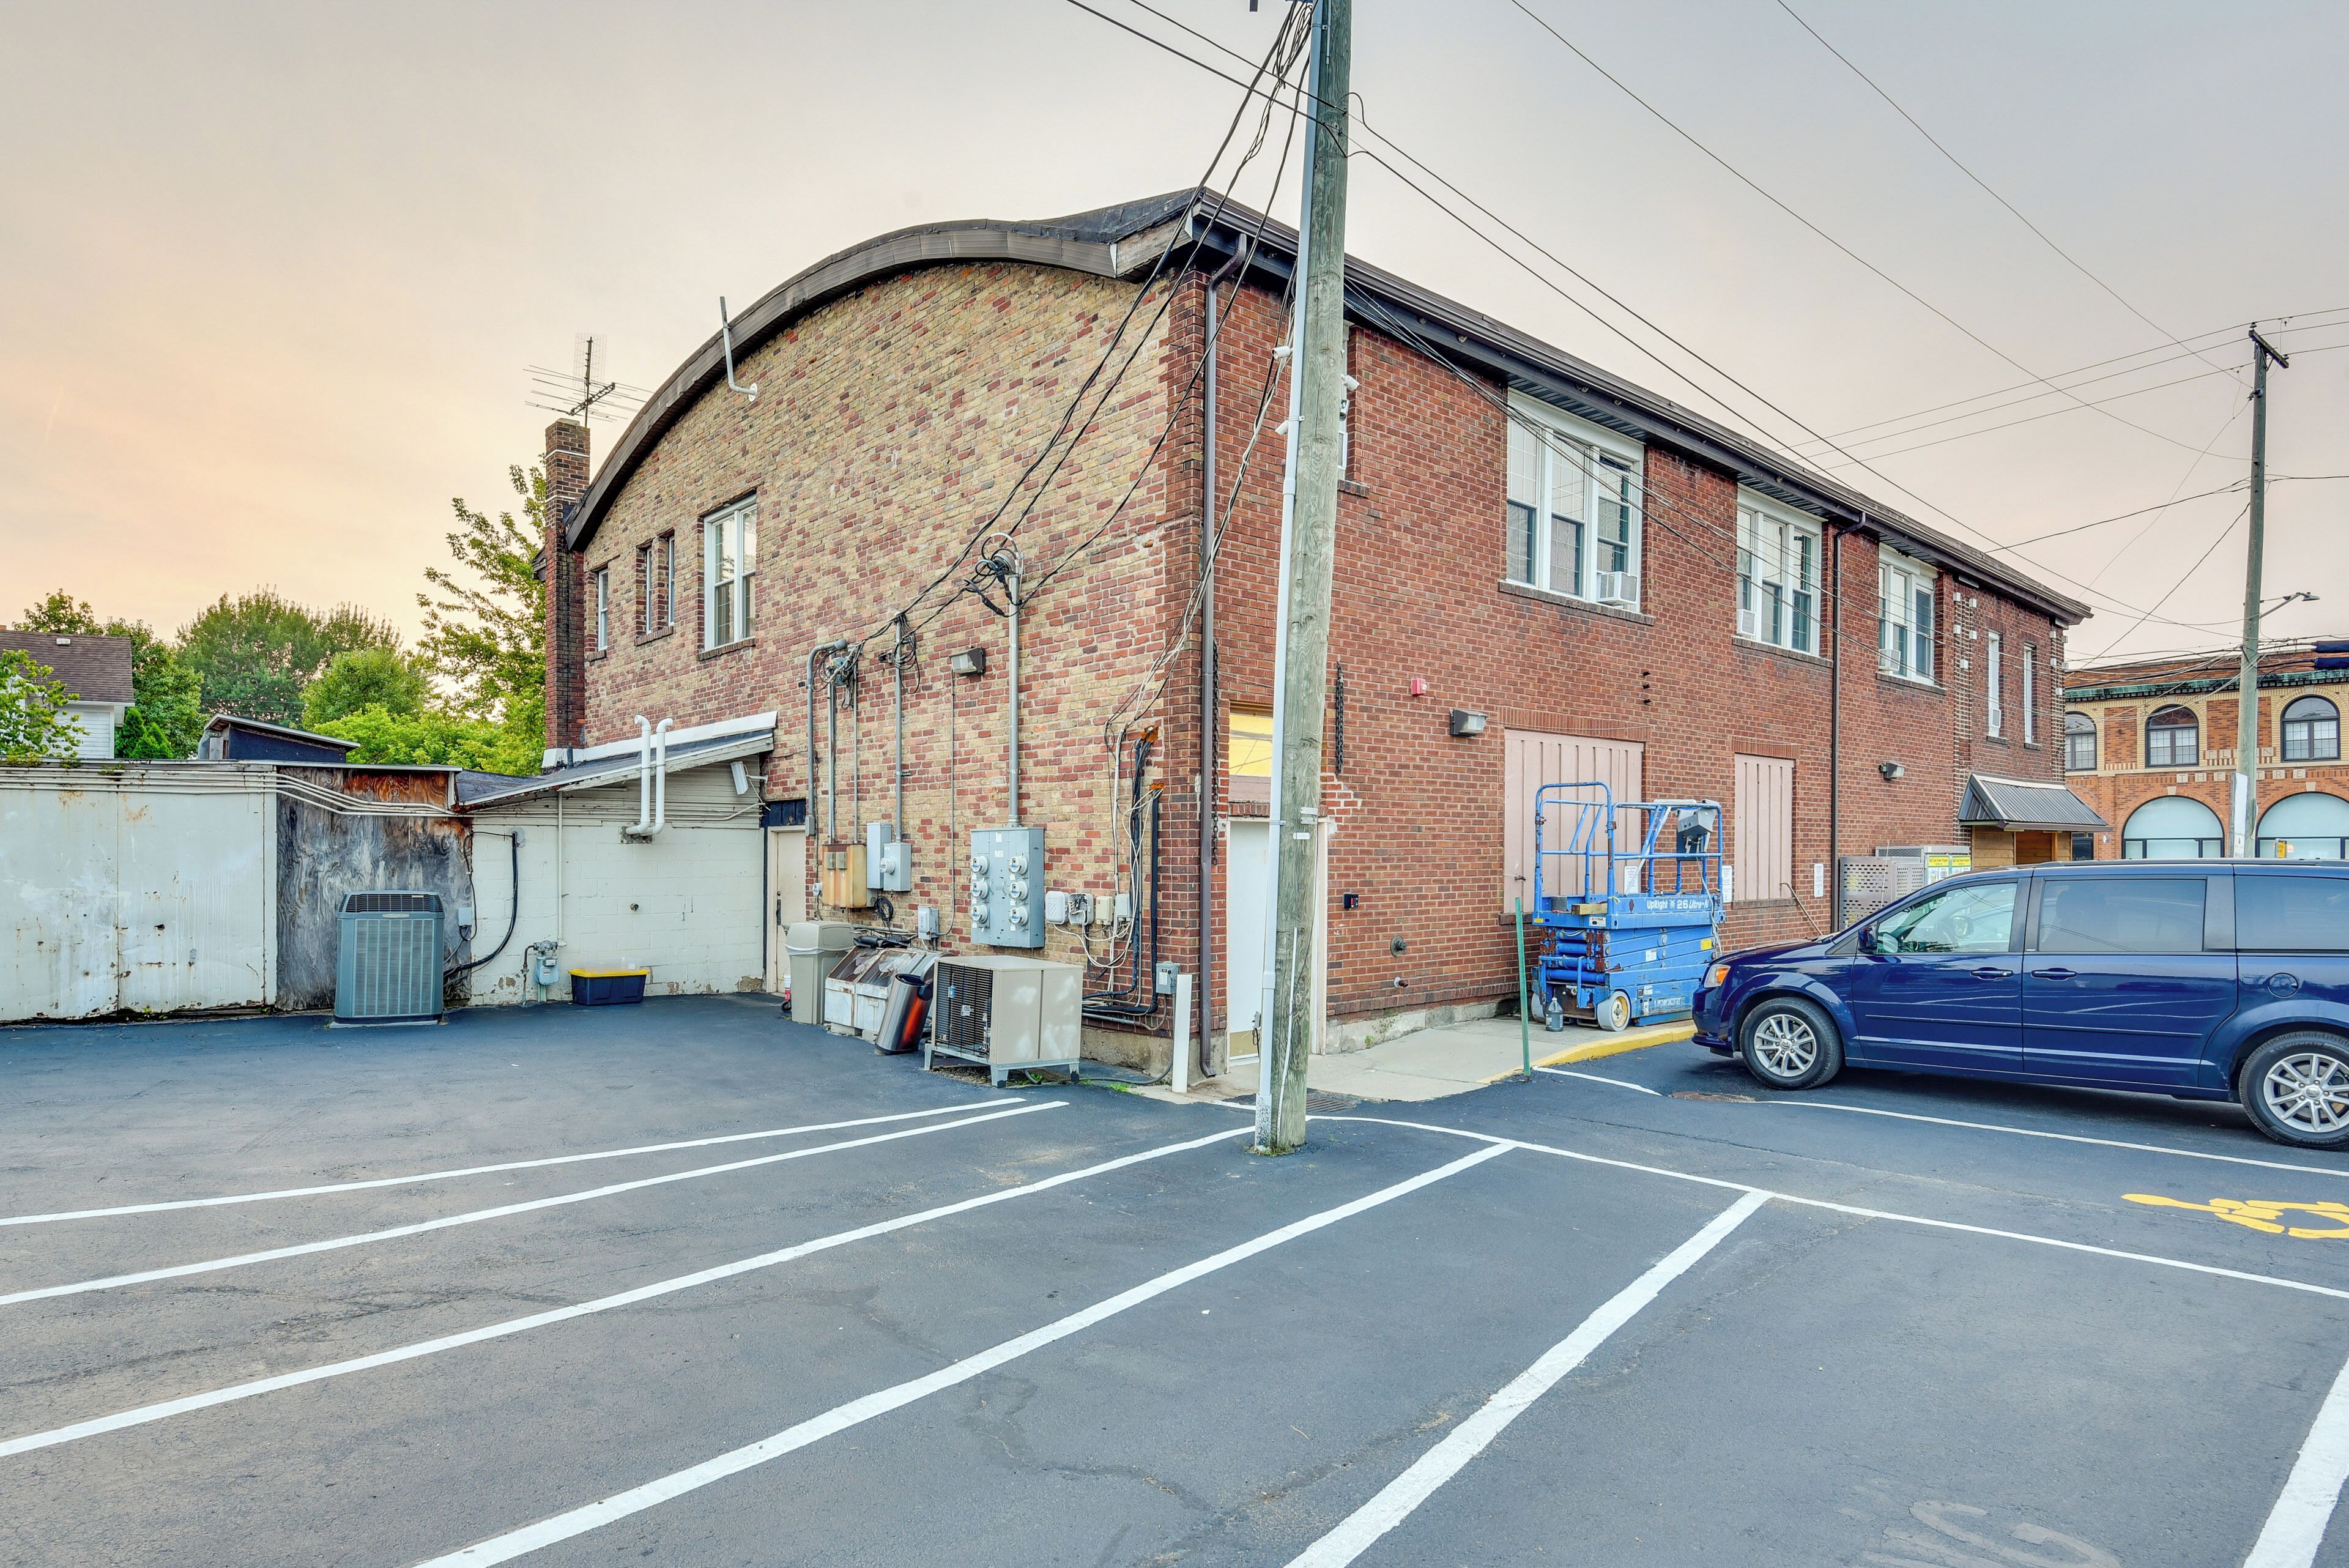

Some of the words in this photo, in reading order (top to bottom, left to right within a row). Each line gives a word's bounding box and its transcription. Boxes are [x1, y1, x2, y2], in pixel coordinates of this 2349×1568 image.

[2208, 748, 2272, 758] FLN
[2179, 769, 2303, 782] THETRE
[1647, 900, 1668, 910] UpRight
[1677, 900, 1688, 909] 26
